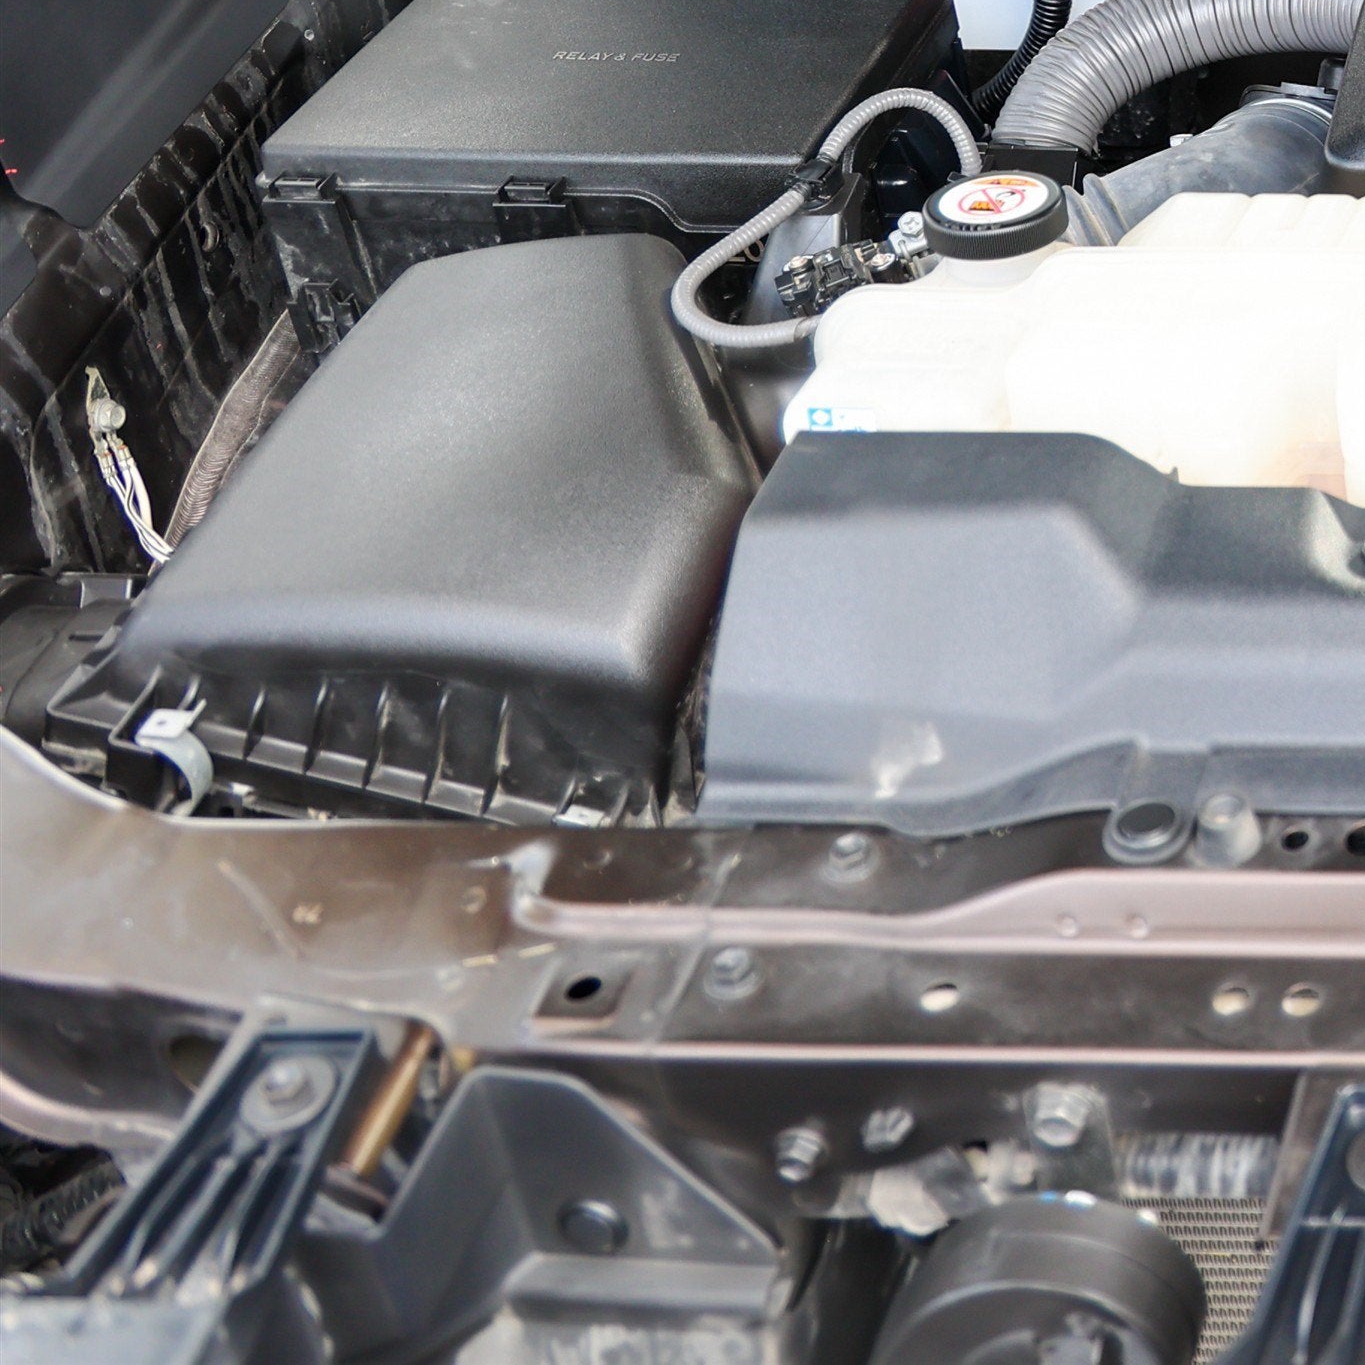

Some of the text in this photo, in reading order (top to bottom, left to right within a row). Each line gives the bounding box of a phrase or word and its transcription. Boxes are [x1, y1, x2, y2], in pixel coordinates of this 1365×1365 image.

[552, 51, 681, 62] RELAY & FUSE
